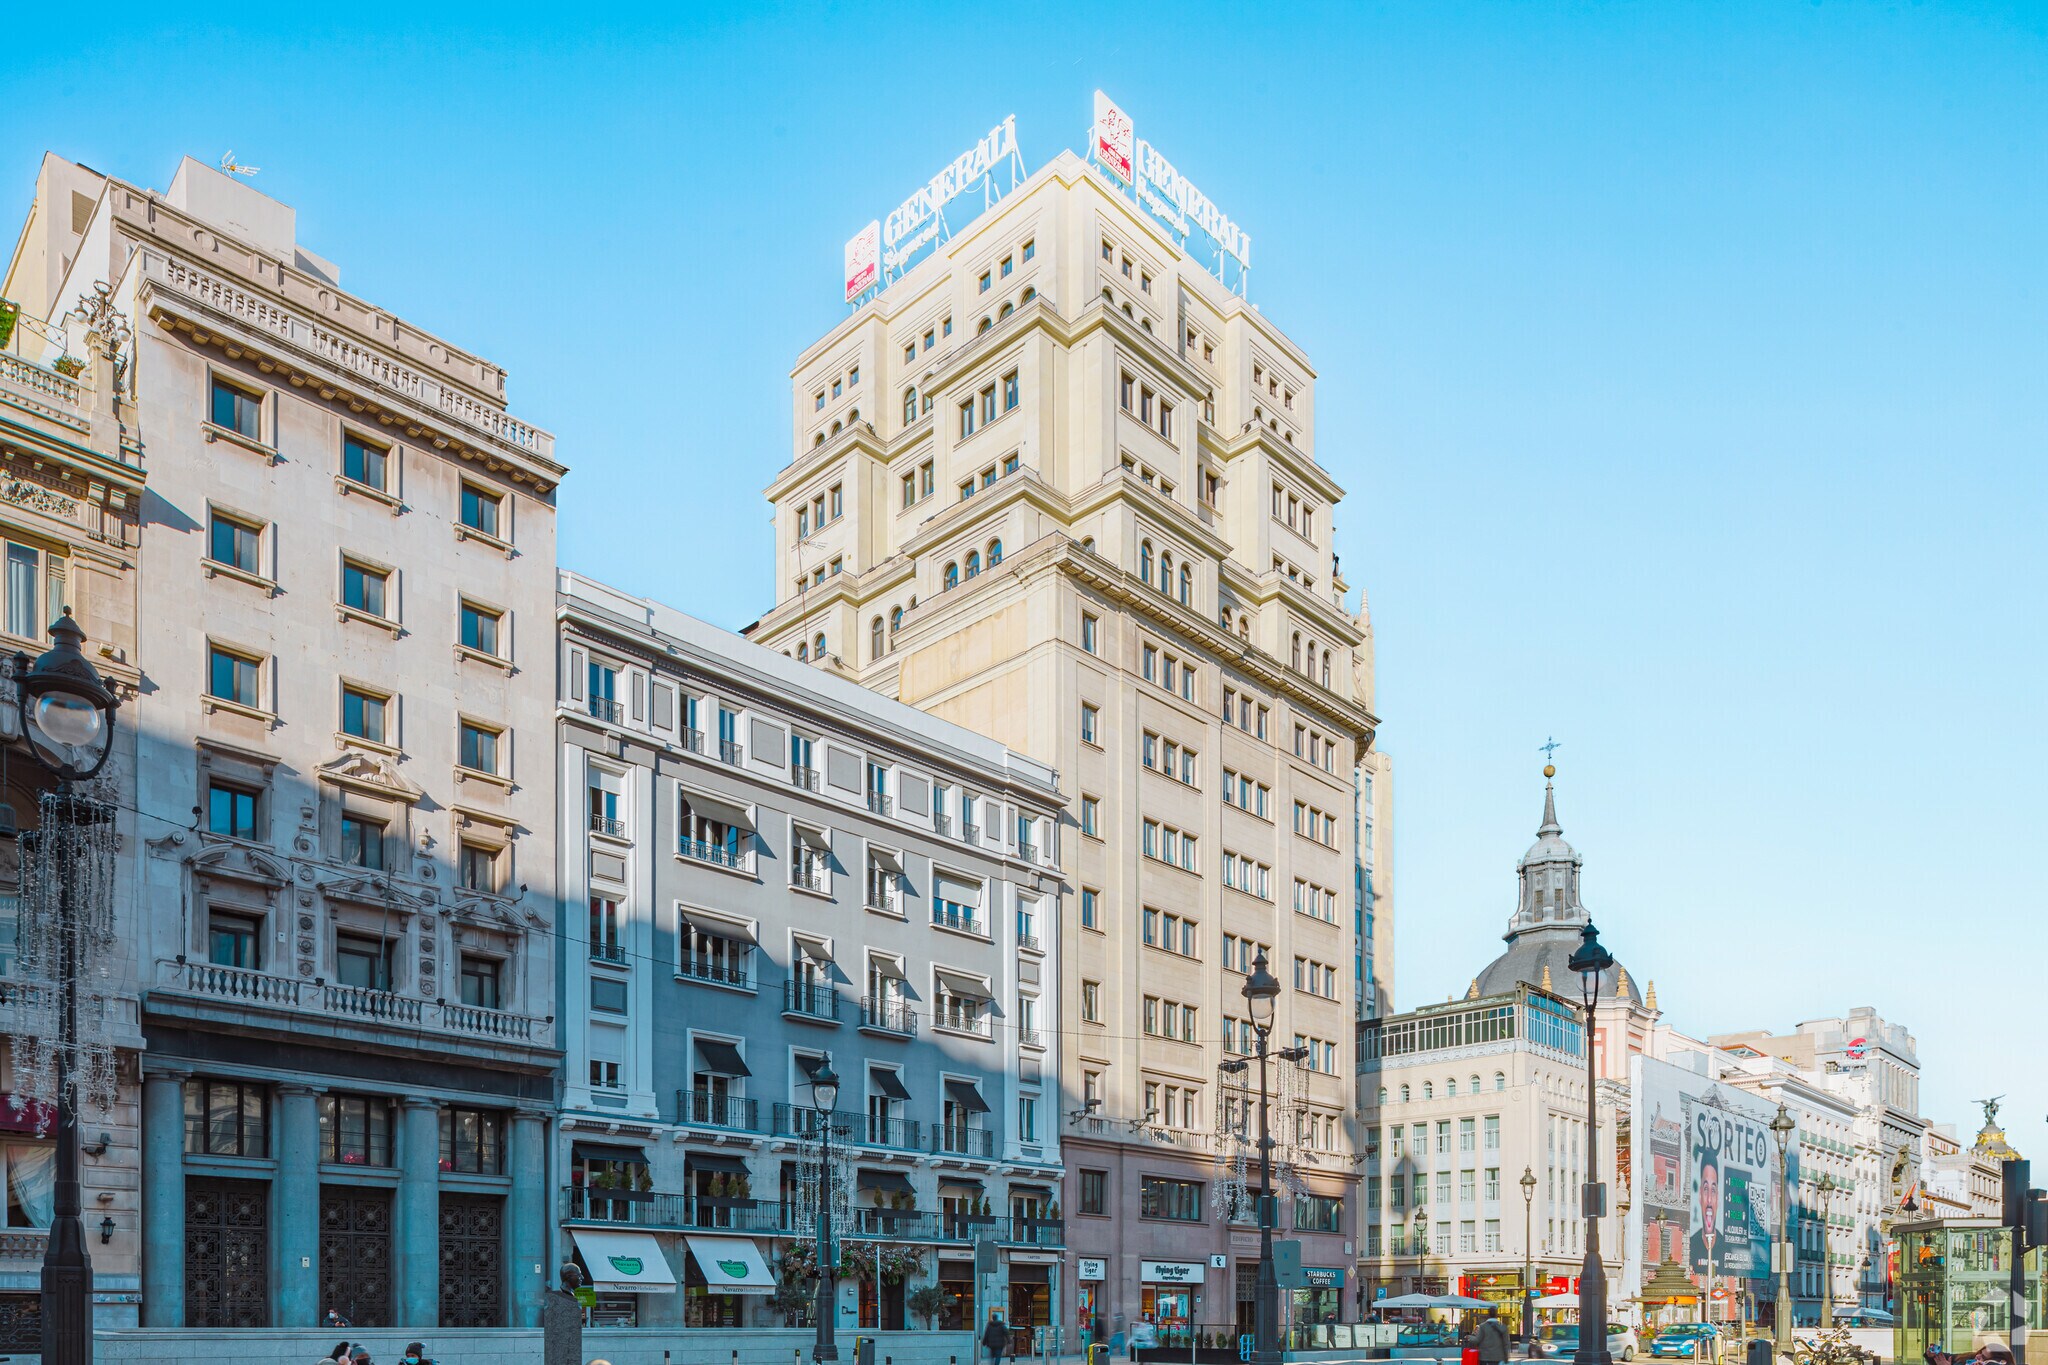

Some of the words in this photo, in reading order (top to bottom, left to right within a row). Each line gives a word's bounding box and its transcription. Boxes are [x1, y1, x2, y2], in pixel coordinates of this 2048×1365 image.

[884, 113, 1016, 247] GENERALI
[1138, 139, 1251, 269] GENERALI
[1697, 1112, 1767, 1168] SORTEO
[1084, 1261, 1098, 1269] flying
[1155, 1265, 1174, 1275] flying
[1174, 1266, 1190, 1275] tiger
[1307, 1270, 1336, 1278] STARBUCKS
[613, 1283, 637, 1291] Navarro
[722, 1285, 743, 1293] Navarro
